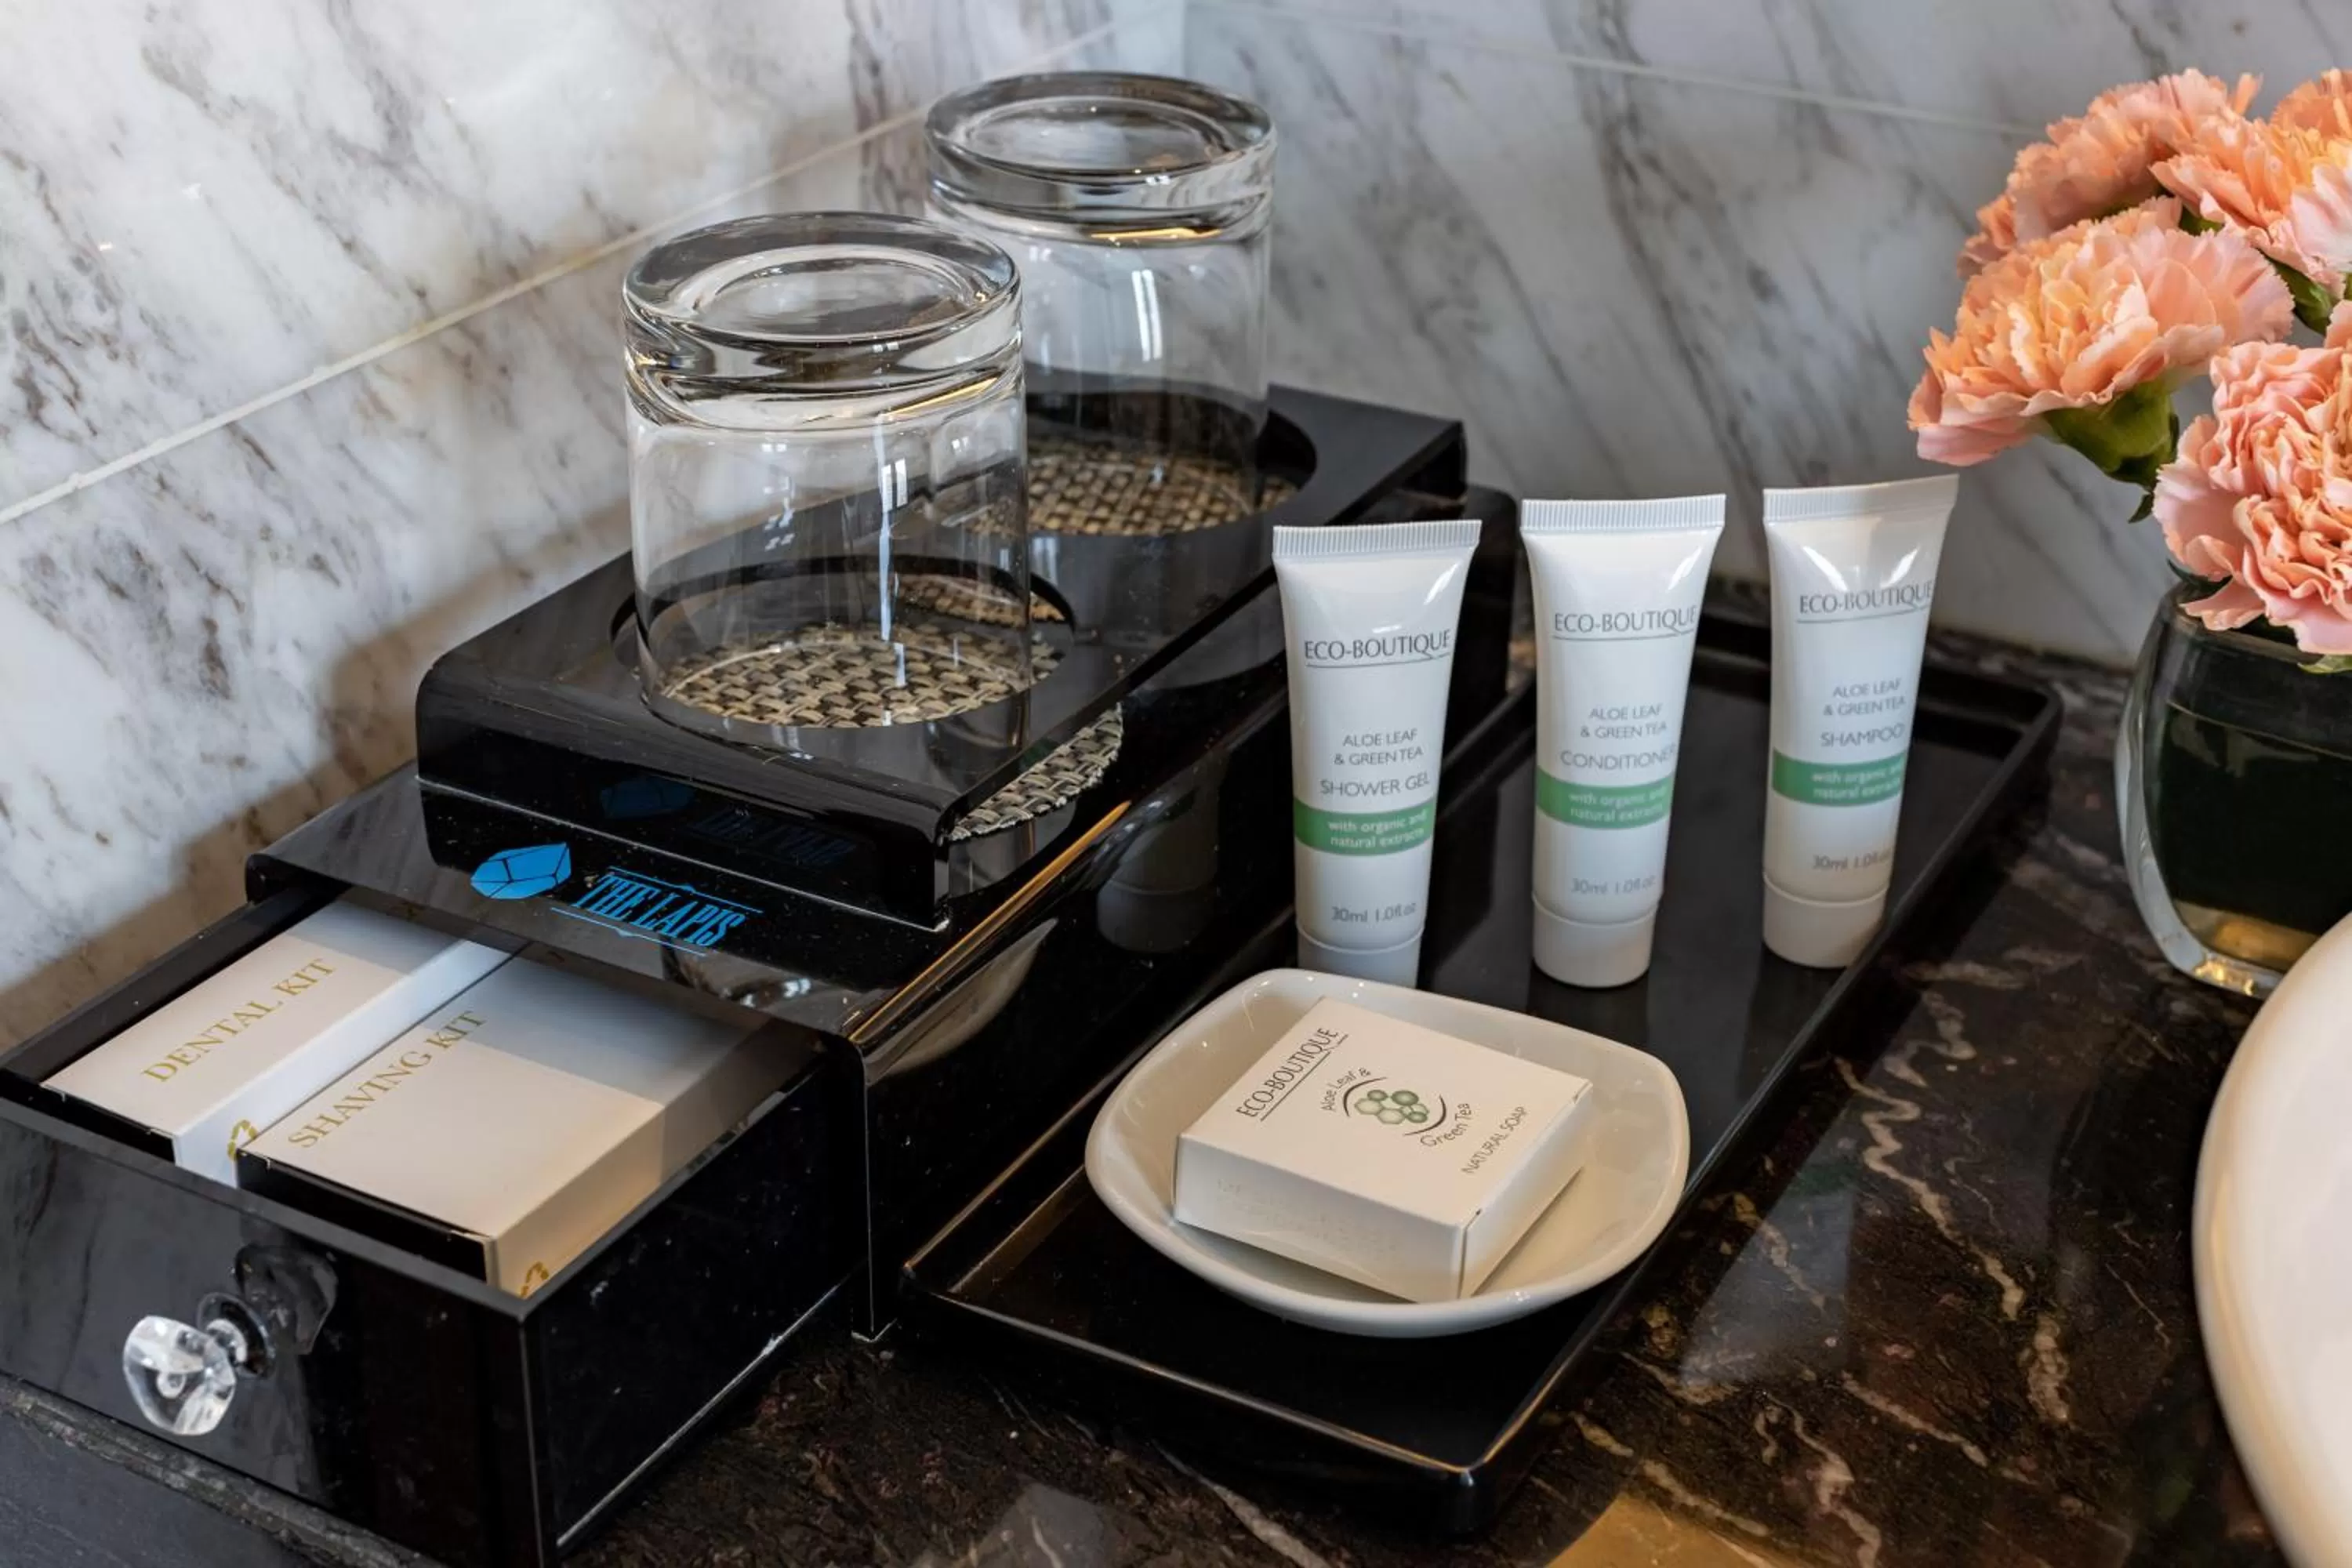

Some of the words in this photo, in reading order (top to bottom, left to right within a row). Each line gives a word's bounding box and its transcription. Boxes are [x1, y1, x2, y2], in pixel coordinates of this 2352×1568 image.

[1798, 581, 1933, 614] ECO-BOUTIQUE
[1554, 605, 1697, 633] ECO-BOUTIQUE
[1304, 630, 1450, 660] ECO-BOUTIQUE
[1832, 683, 1870, 698] ALOE
[1873, 677, 1902, 695] LEAF
[1588, 707, 1628, 720] ALOE
[1632, 702, 1663, 720] LEAF
[1823, 704, 1833, 716] &
[1837, 700, 1882, 717] GREEN
[1885, 695, 1907, 710] TEA
[1342, 733, 1384, 747] ALOE
[1385, 728, 1417, 746] LEAF
[1580, 726, 1590, 738] &
[1594, 726, 1642, 739] GREEN
[1646, 720, 1668, 735] TEA
[1820, 722, 1906, 748] SHAMPOO
[1334, 753, 1345, 765] &
[1348, 751, 1396, 766] GREEN
[1399, 746, 1425, 760] TEA
[1319, 779, 1401, 797] SHOWER
[1404, 771, 1431, 791] GEL
[1328, 820, 1357, 833] with
[1360, 817, 1406, 835] organic
[1330, 836, 1376, 848] natural
[1571, 877, 1607, 895] 30ml
[572, 873, 661, 921] THE
[630, 891, 746, 946] LAPIS
[1331, 906, 1368, 923] 30ml
[142, 1000, 284, 1082] DENTAL
[274, 958, 336, 996] KIT
[288, 1050, 434, 1149] SHAVING
[423, 1010, 488, 1050] KIT
[1236, 1026, 1339, 1119] ECO-BOUTIQUE
[1320, 1084, 1338, 1112] Aloe
[1336, 1069, 1357, 1088] Leaf
[1420, 1120, 1470, 1149] Green
[1454, 1102, 1472, 1127] Tea
[1461, 1132, 1508, 1174] NATURAL
[1500, 1105, 1527, 1133] SOAP
